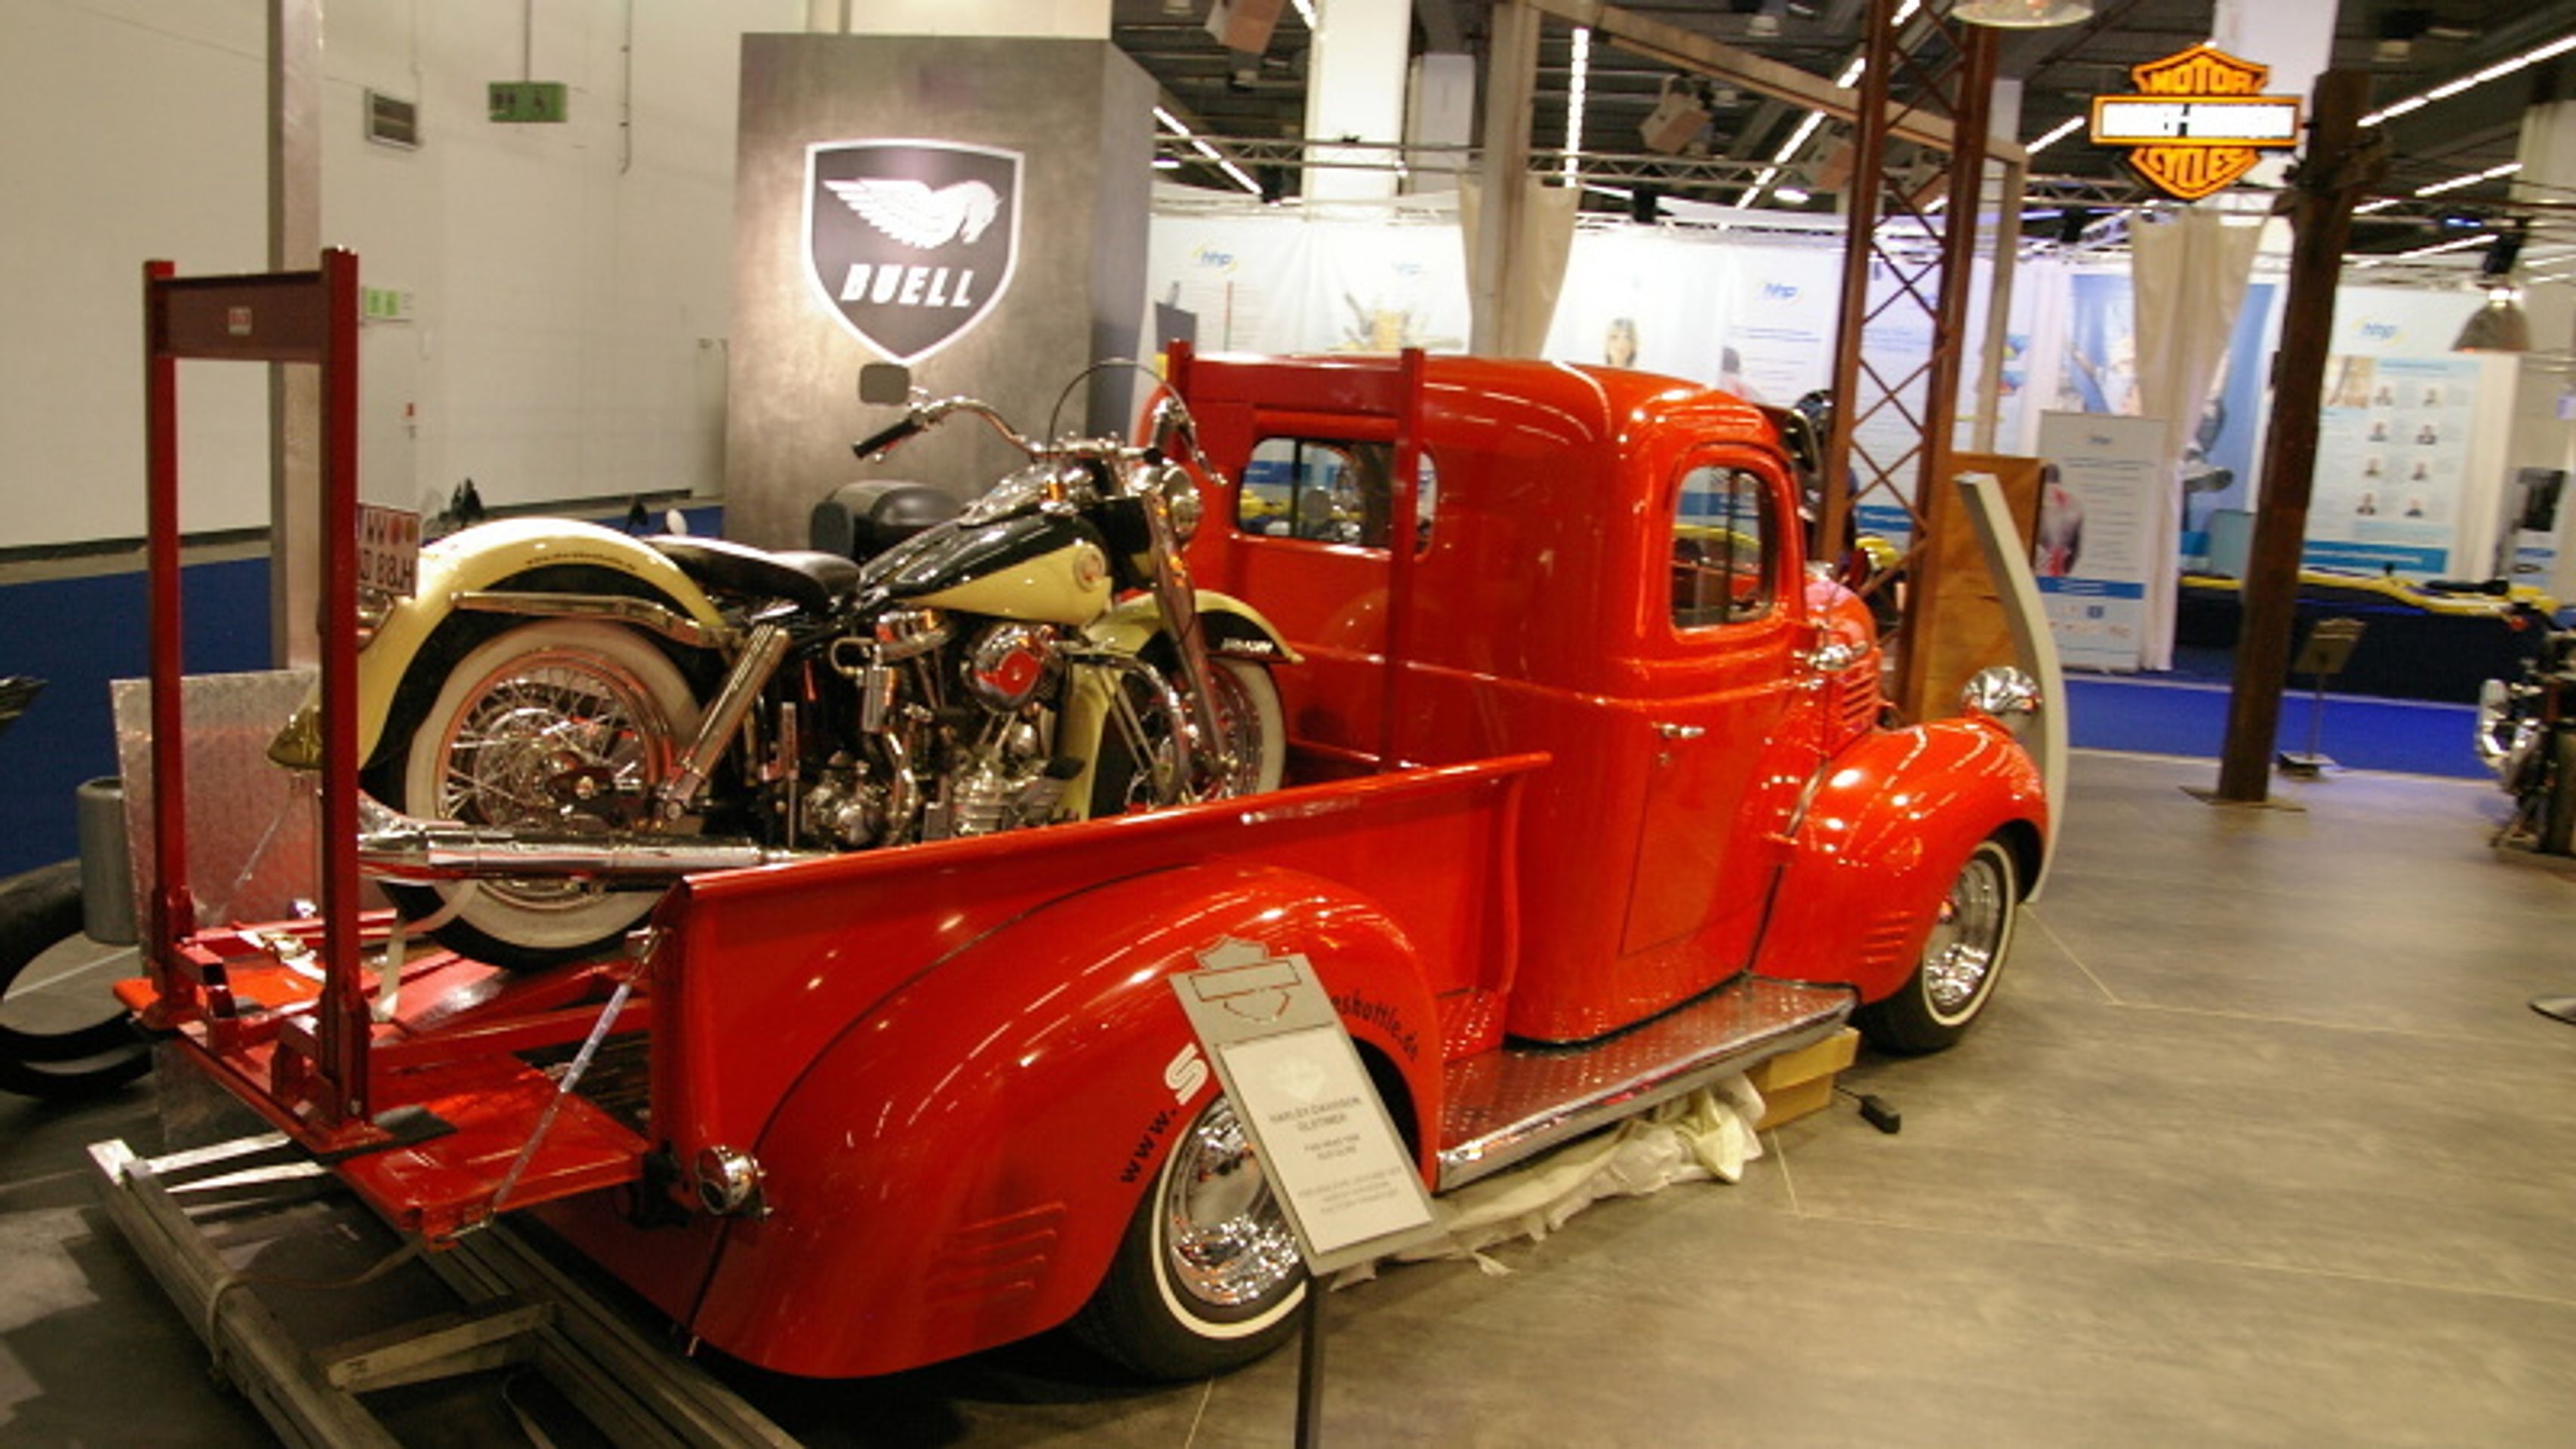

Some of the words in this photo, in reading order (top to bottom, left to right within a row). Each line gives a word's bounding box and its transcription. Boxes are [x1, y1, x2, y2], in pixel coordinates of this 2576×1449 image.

[2150, 56, 2257, 94] MOTOR
[2146, 146, 2247, 189] CYCLES
[840, 264, 974, 307] BUELL
